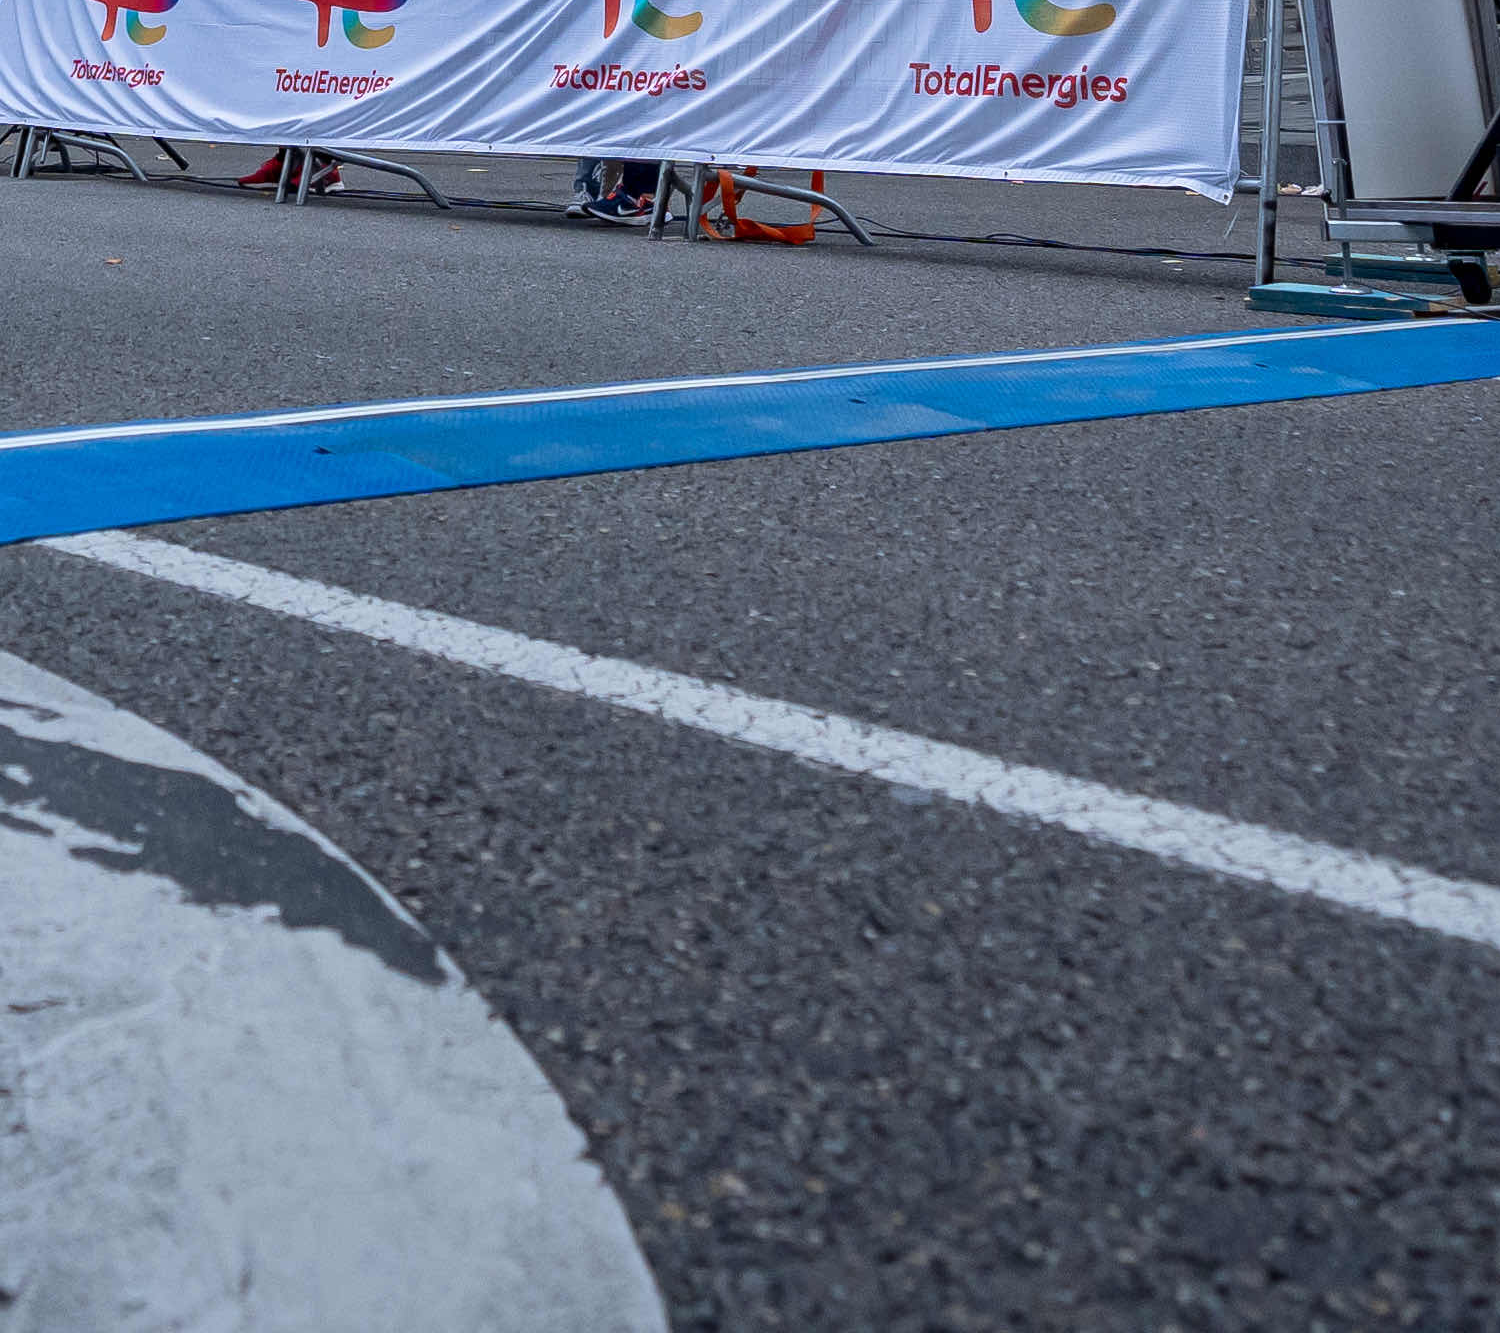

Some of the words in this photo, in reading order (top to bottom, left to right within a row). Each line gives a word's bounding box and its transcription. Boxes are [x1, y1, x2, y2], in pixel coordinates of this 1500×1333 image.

[71, 59, 165, 88] TotalEnergies
[274, 68, 395, 99] TotalEnergies
[552, 61, 707, 96] TotalEnergies
[909, 61, 1128, 109] TotalEnergies
